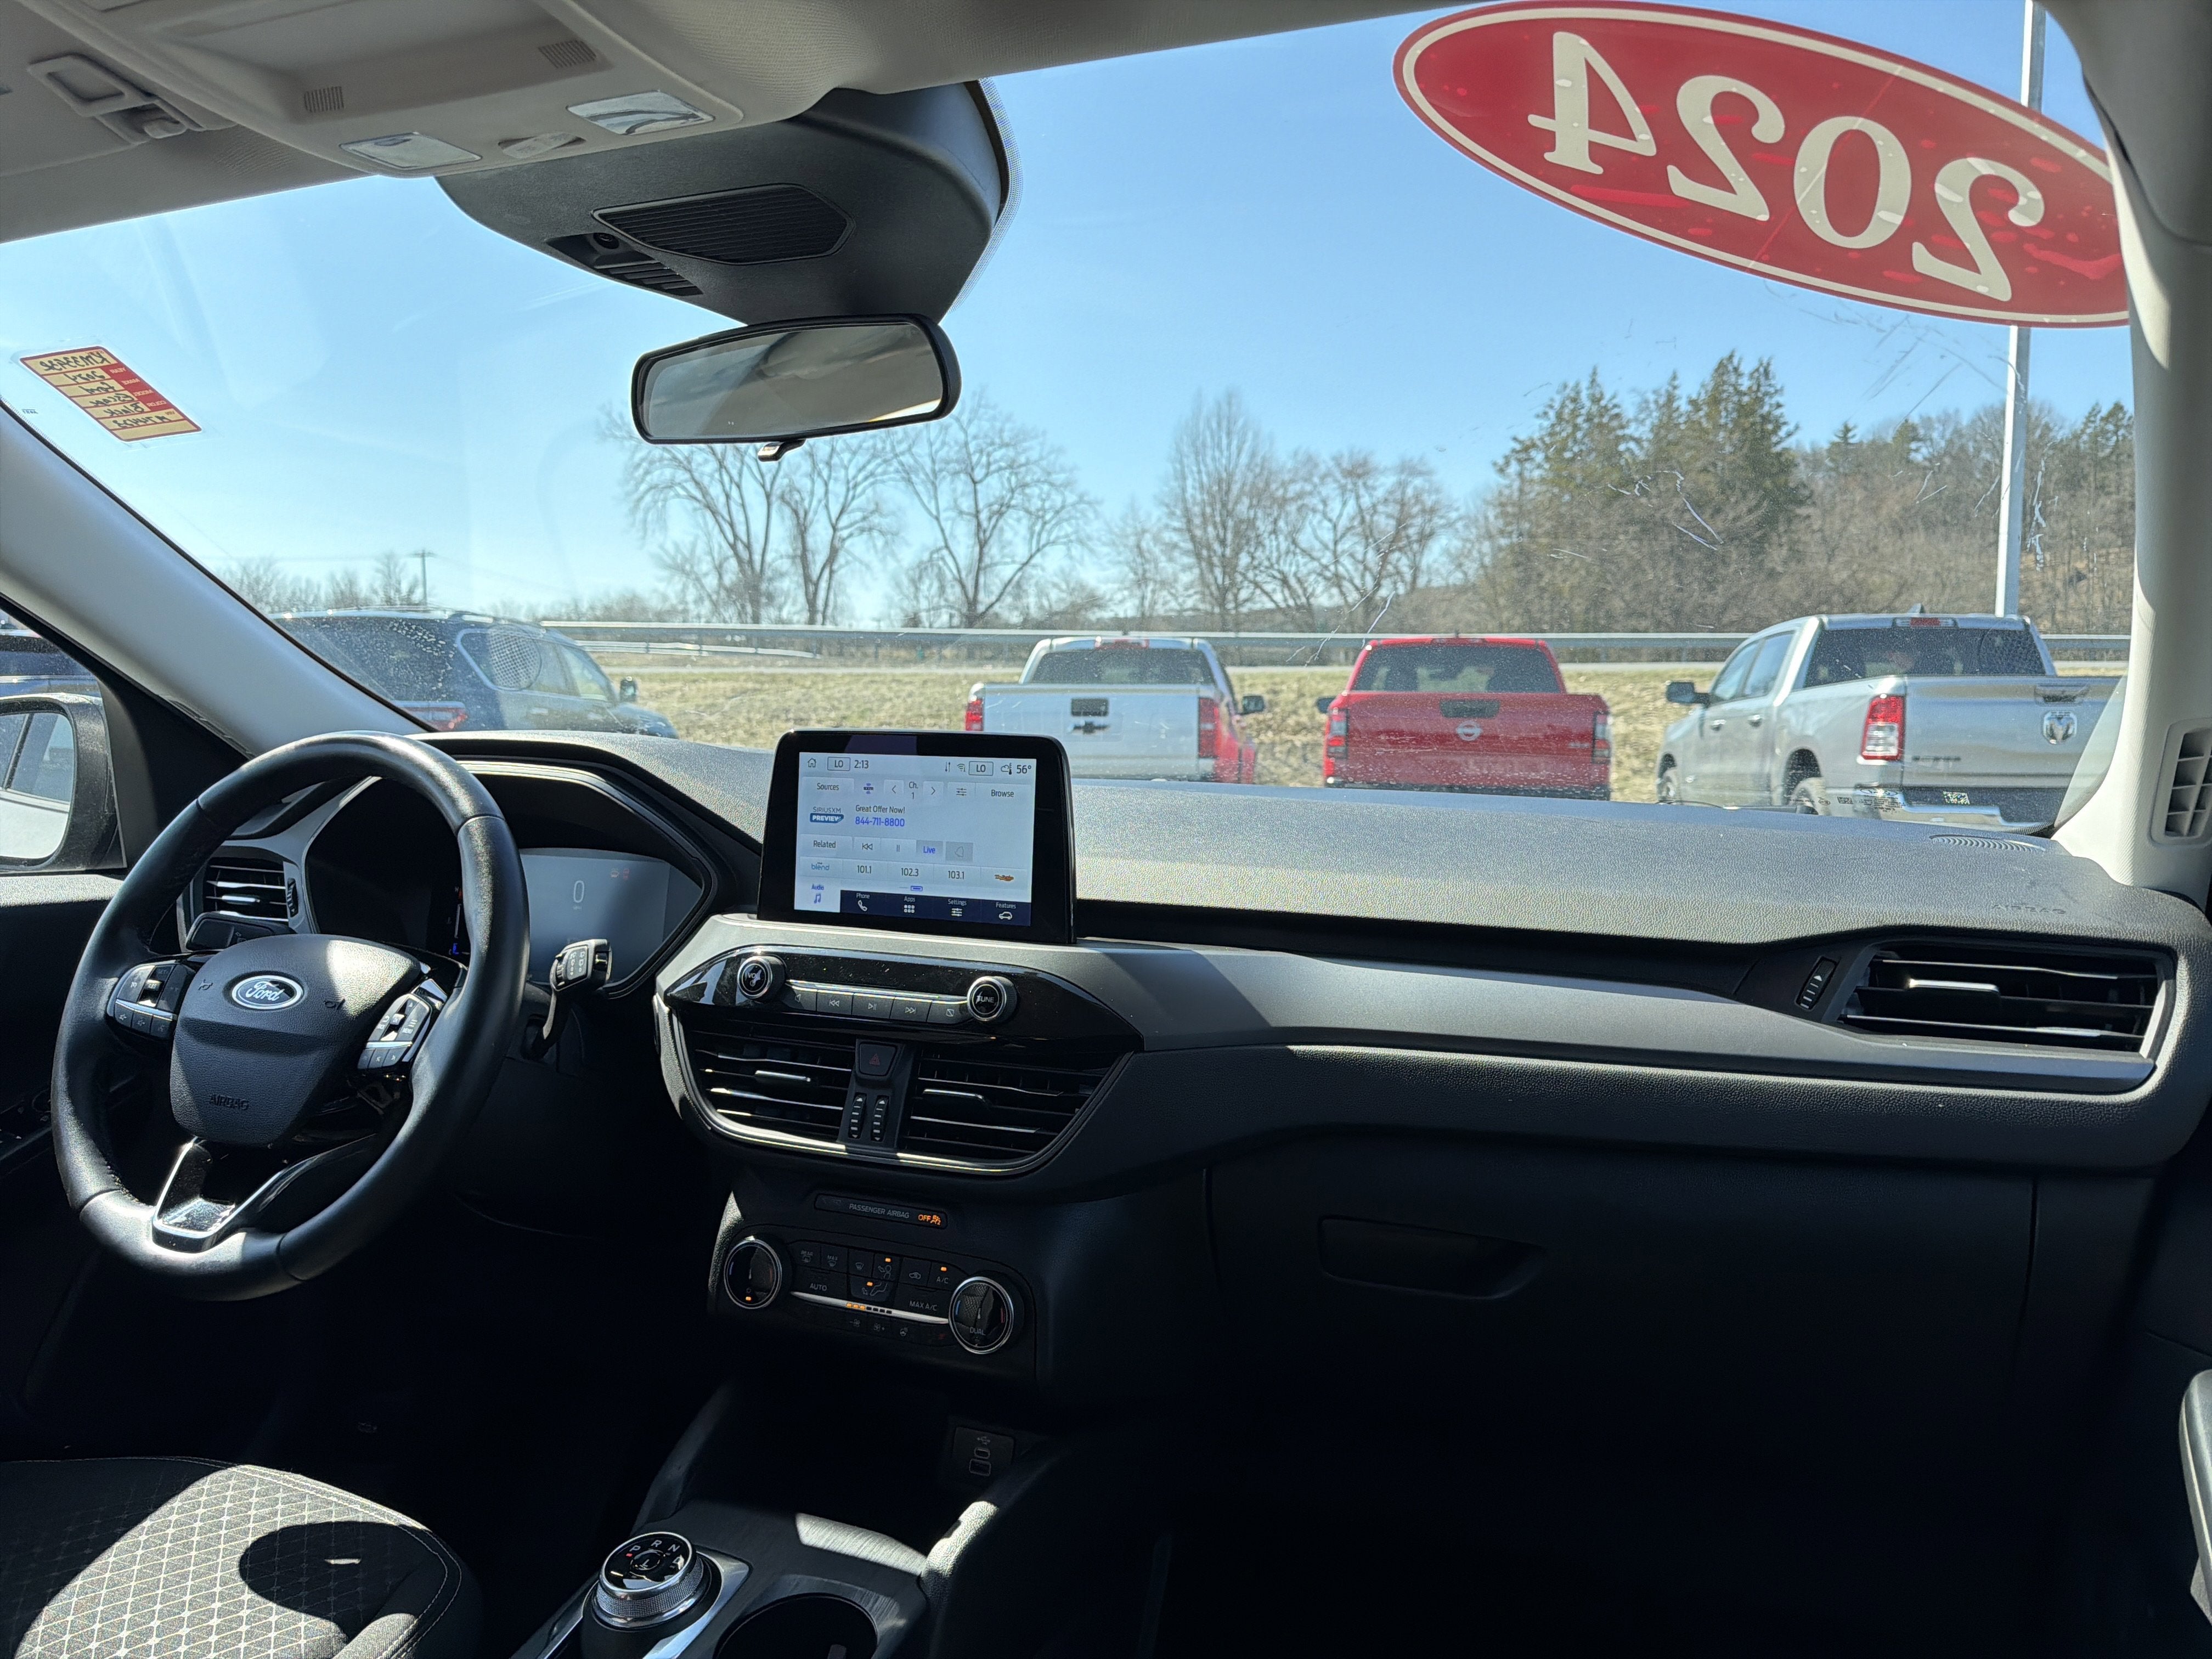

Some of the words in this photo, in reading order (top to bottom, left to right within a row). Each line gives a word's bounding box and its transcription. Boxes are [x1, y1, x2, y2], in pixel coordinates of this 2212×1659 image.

[834, 759, 844, 769] LO
[854, 760, 869, 769] 2:13
[976, 764, 986, 774] LO
[1016, 764, 1032, 775] 56°
[816, 782, 839, 792] Sources
[909, 781, 918, 789] Ch.
[991, 789, 1014, 798] Browse
[855, 816, 905, 827] 844-711-8800
[813, 840, 837, 848] Related
[923, 845, 935, 854] Live
[857, 865, 872, 874] 101.1
[901, 867, 919, 877] 102.3
[947, 870, 965, 879] 103.1
[573, 880, 585, 903] 0
[856, 892, 870, 900] Phone
[904, 896, 916, 904] Apps
[995, 902, 1016, 910] Features
[245, 981, 286, 1002] Ford
[977, 995, 995, 1003] TUNE
[208, 1094, 250, 1111] AIRBAG
[849, 1203, 885, 1216] PASSENGER
[887, 1209, 910, 1219] AIRBAG
[918, 1214, 931, 1222] OFF
[936, 1276, 949, 1284] A/C
[809, 1283, 827, 1291] AUTO
[909, 1300, 924, 1308] MAX
[969, 1327, 986, 1336] DUAL
[651, 1539, 663, 1548] R
[667, 1544, 680, 1552] N
